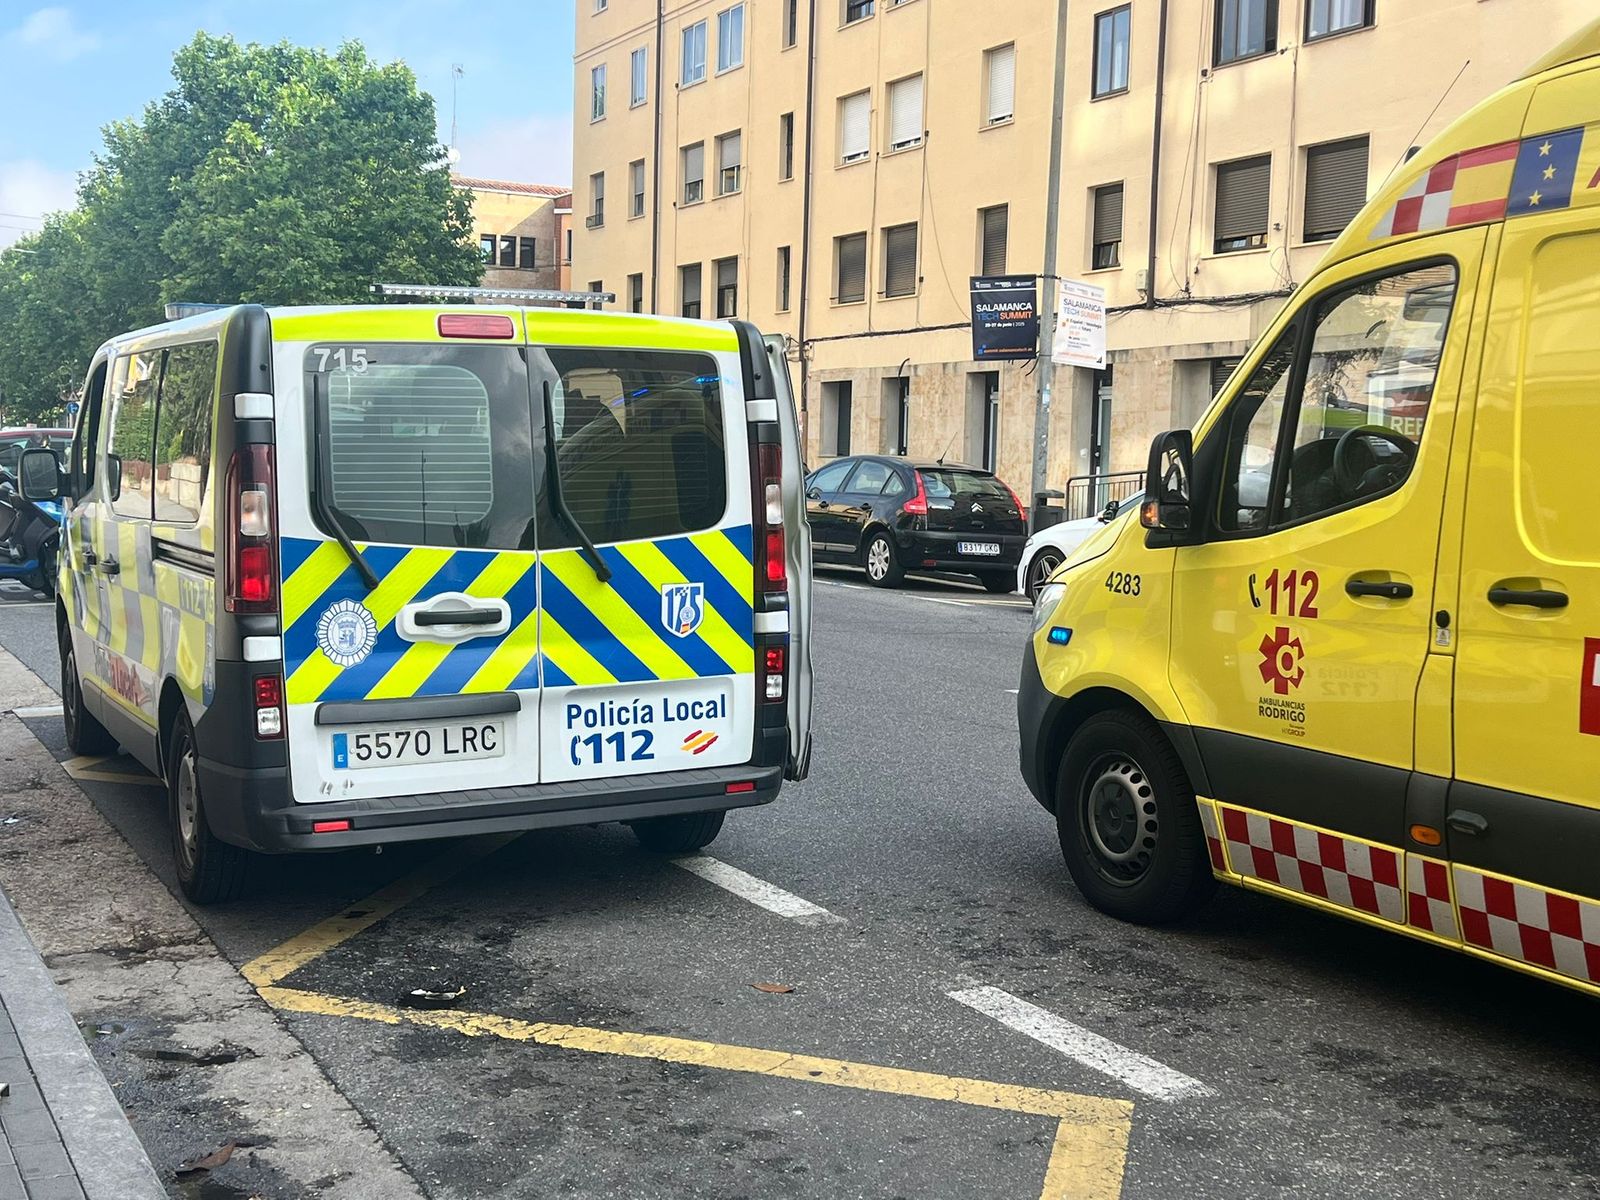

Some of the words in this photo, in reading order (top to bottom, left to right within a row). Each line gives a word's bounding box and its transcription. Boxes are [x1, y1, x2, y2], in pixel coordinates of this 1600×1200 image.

[976, 302, 1032, 312] SALAMANCA
[1063, 298, 1102, 313] SALAMANCA
[1063, 306, 1080, 317] TECH
[977, 312, 999, 321] TECH
[1000, 311, 1032, 320] SUMMIT
[314, 348, 368, 373] 715
[963, 543, 982, 552] 8317
[1105, 571, 1141, 596] 4283
[1265, 568, 1319, 619] 112
[567, 698, 653, 730] Policía
[663, 694, 726, 722] Local
[1259, 697, 1305, 711] AMBULANCIAS
[1259, 706, 1305, 723] RODRIGO
[355, 729, 431, 761] 5570
[442, 725, 496, 755] LRC
[582, 729, 655, 764] 112
[337, 754, 344, 762] E
